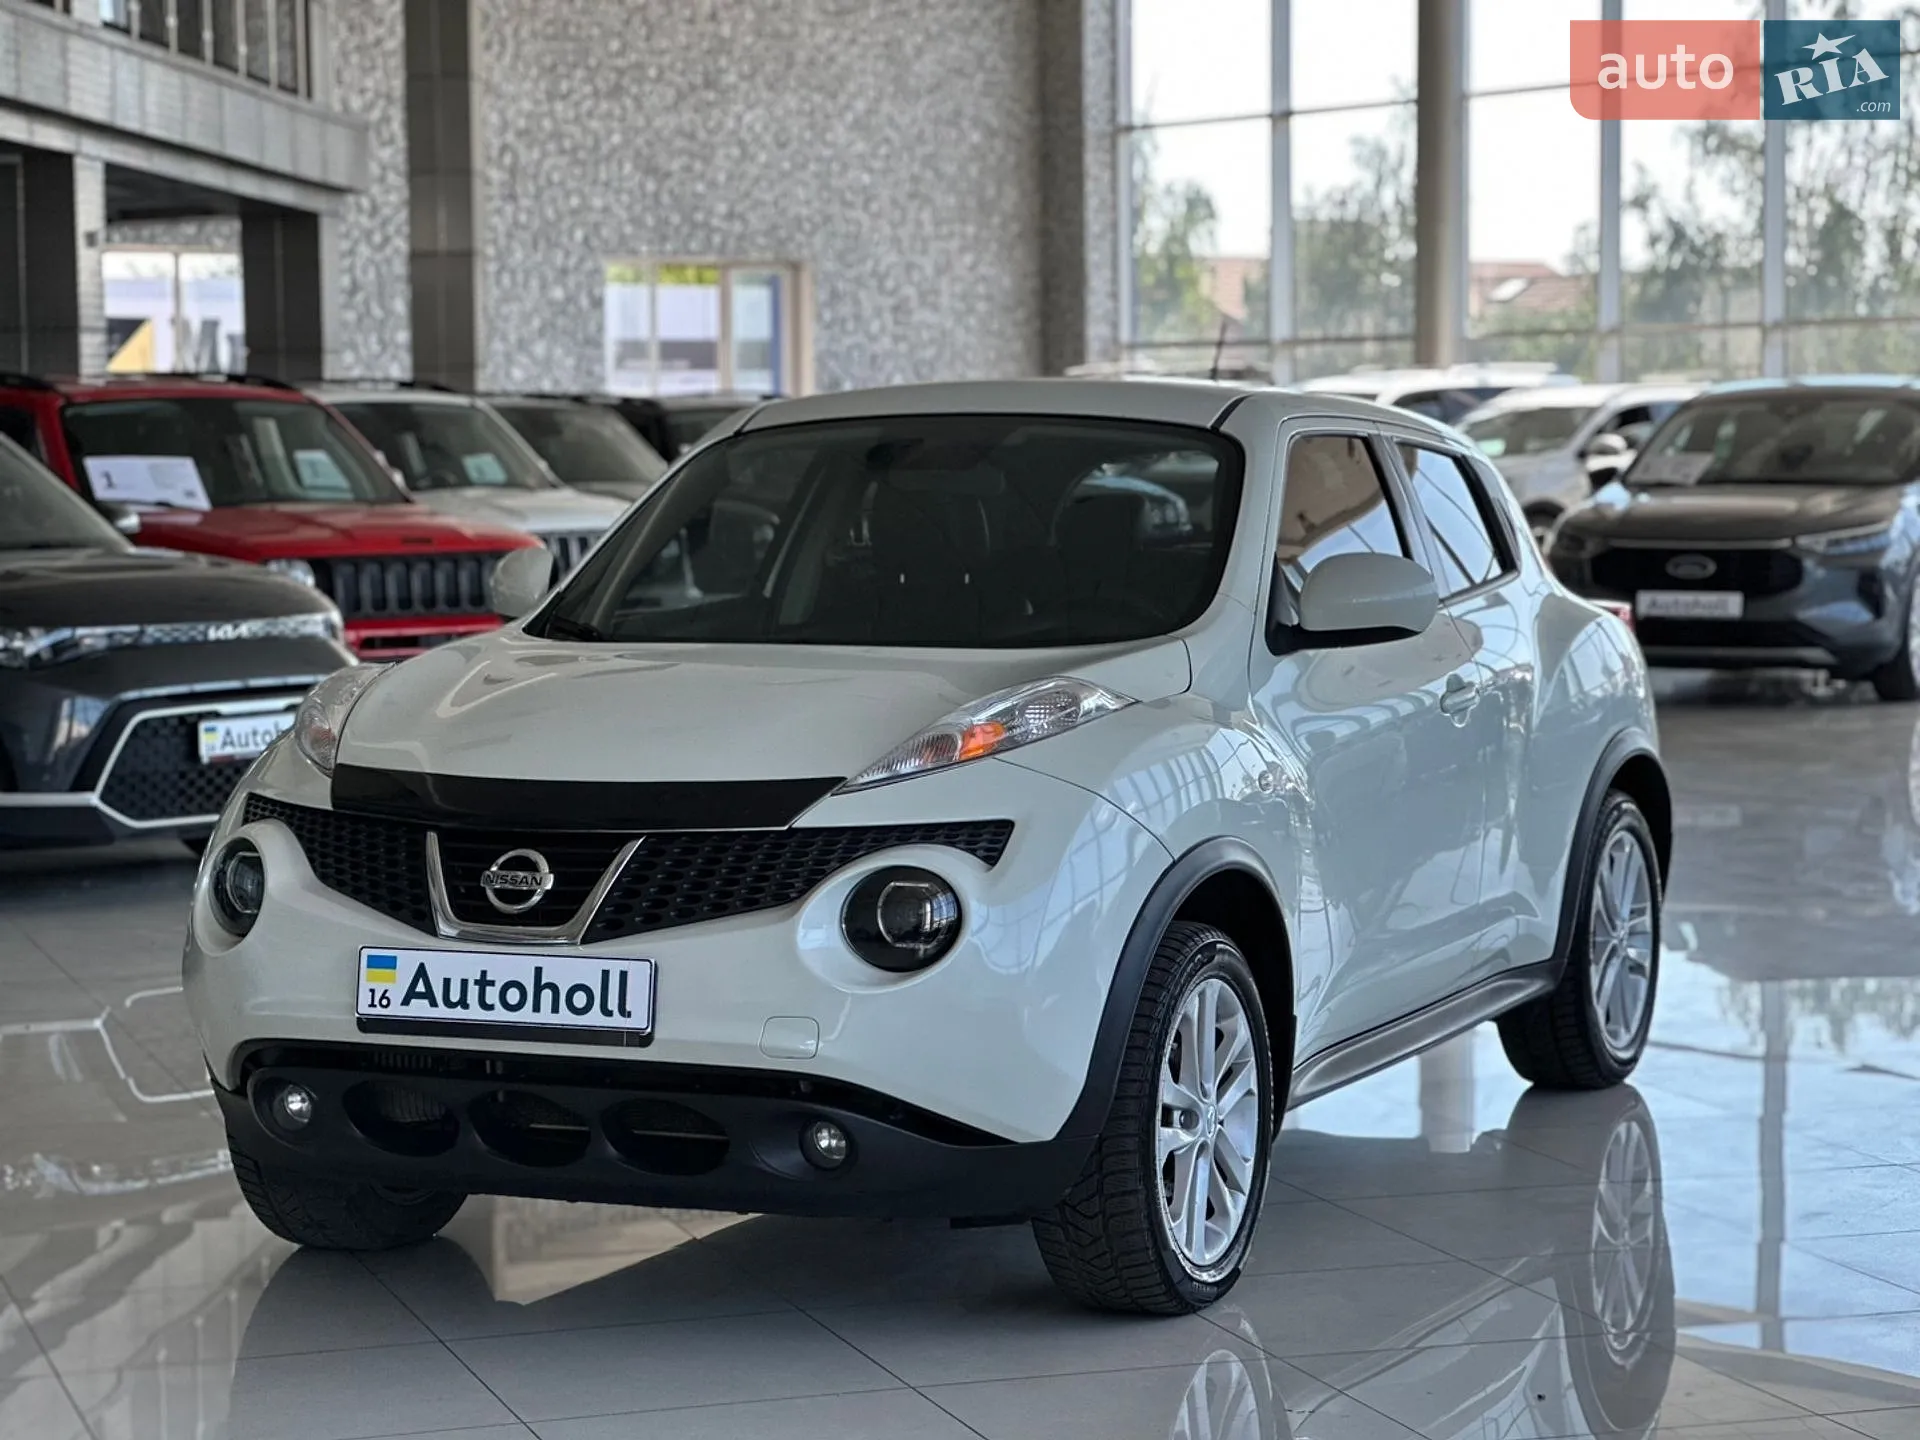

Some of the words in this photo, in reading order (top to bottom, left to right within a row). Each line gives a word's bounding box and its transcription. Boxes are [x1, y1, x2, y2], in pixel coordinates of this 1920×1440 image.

[483, 871, 543, 887] NISSAN
[367, 988, 391, 1009] 16
[400, 962, 632, 1019] Autoholl
